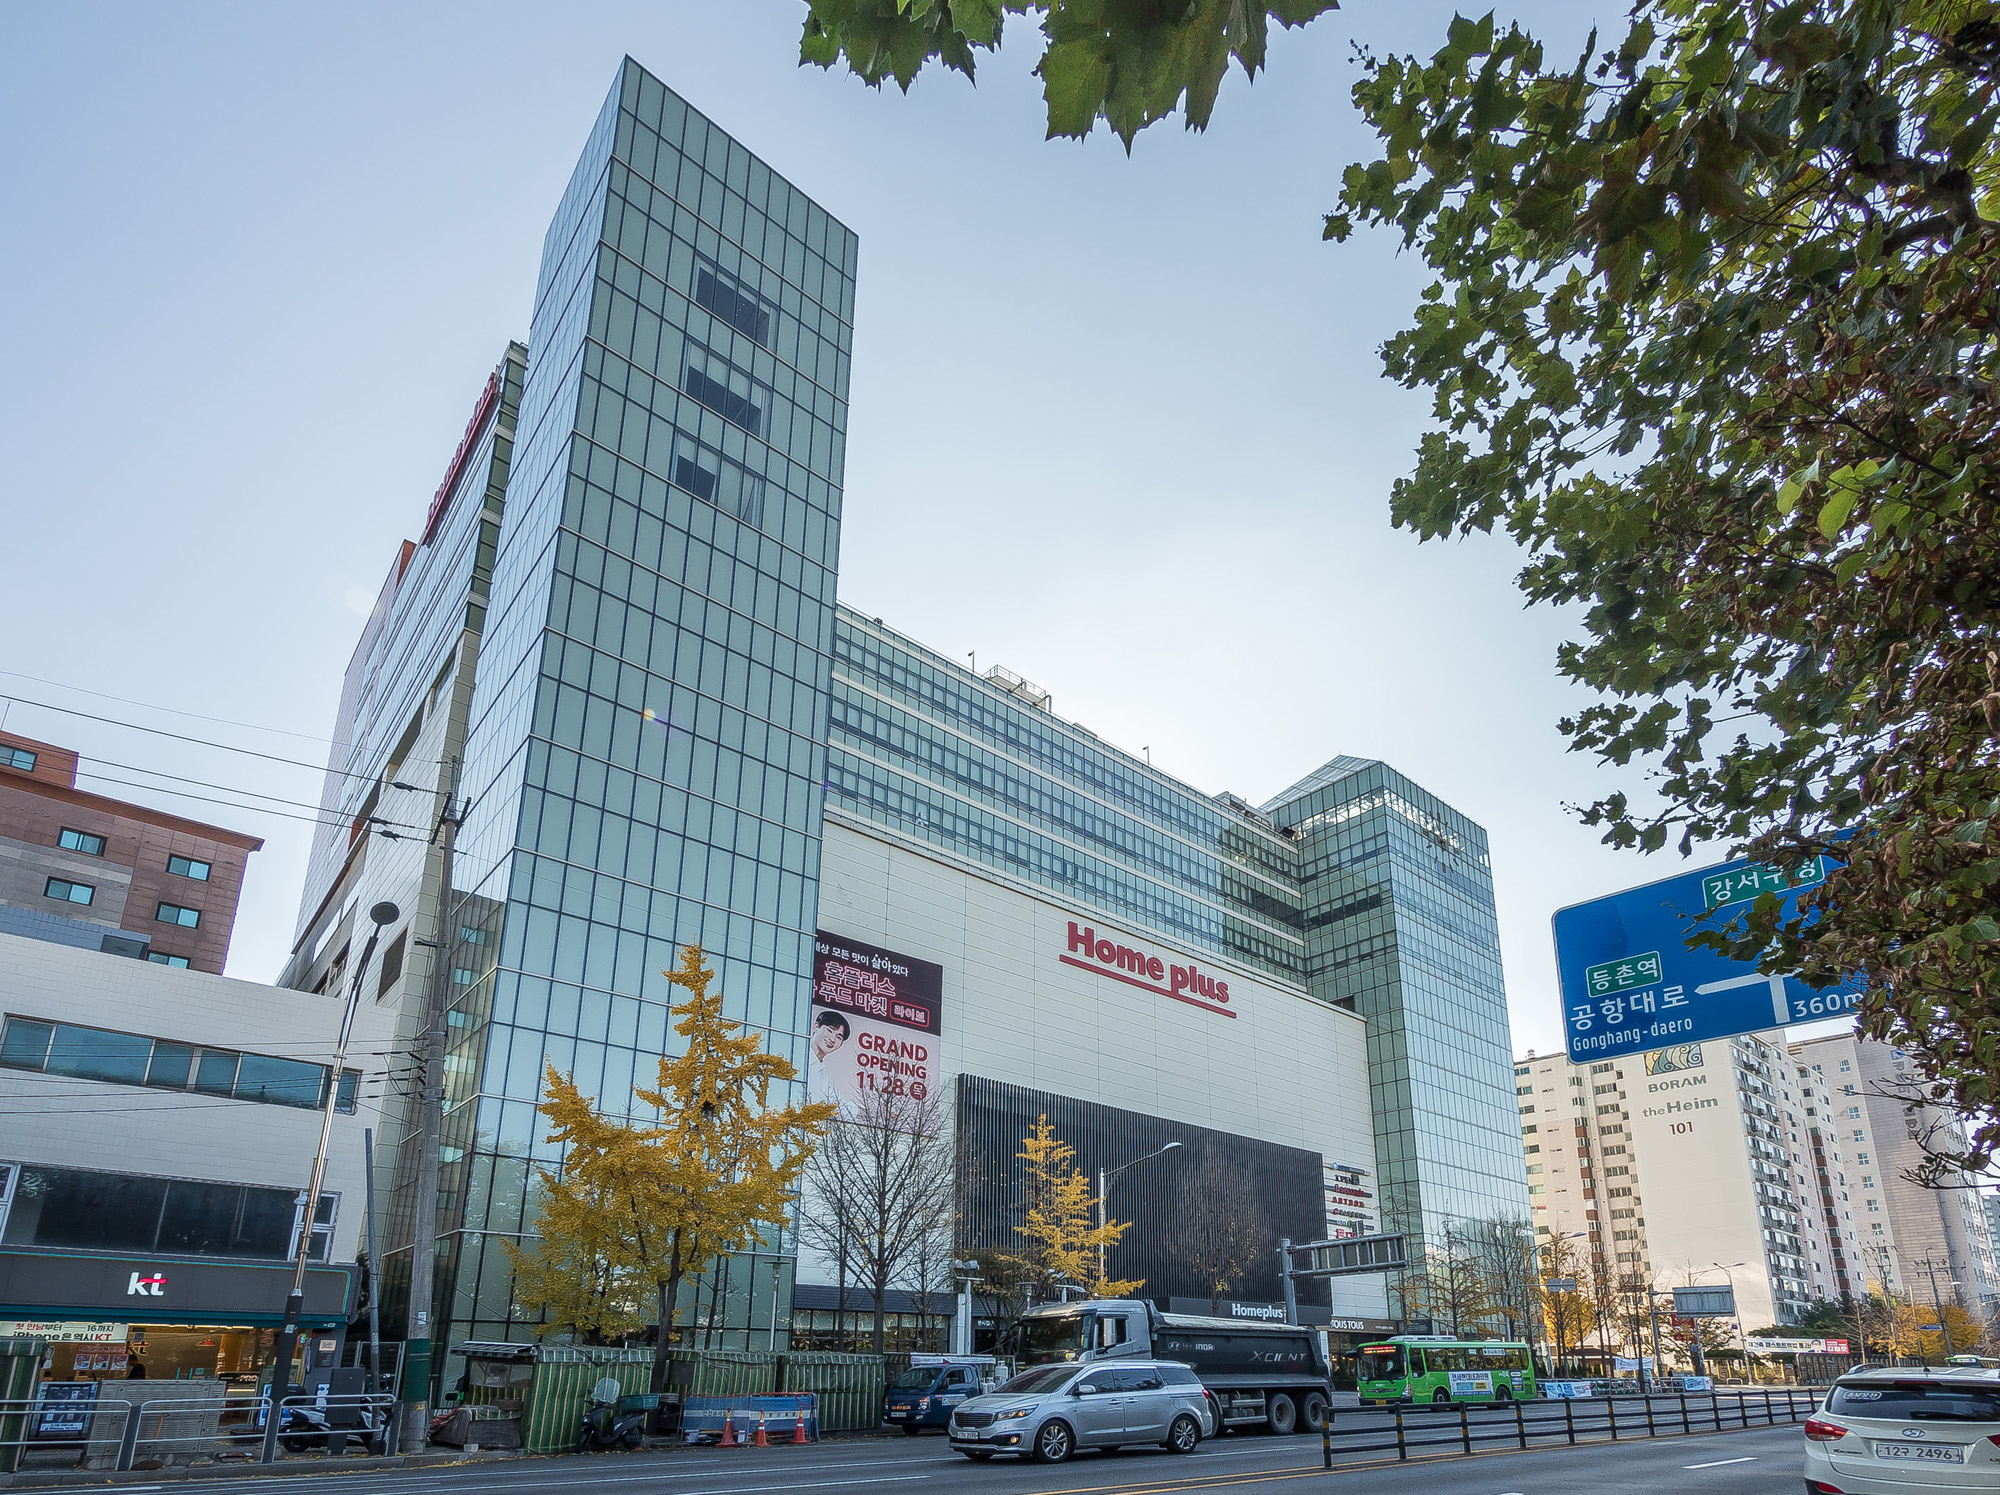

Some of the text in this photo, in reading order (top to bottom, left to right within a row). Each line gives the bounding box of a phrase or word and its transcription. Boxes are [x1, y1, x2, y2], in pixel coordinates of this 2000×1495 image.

[832, 946, 850, 960] 모든
[851, 952, 869, 966] 맛이
[1067, 920, 1230, 1003] Home plus
[824, 961, 896, 997] 홈플러스
[1591, 957, 1658, 990] 등촌역
[894, 1005, 926, 1023] 라이브
[1570, 985, 1689, 1030] 공항대로
[1793, 993, 1864, 1018] 360m
[858, 1032, 928, 1062] GRAND
[1573, 1018, 1693, 1051] Gonghang-daero
[857, 1052, 927, 1079] OPENING
[1648, 1075, 1707, 1093] BORAM
[1669, 1121, 1693, 1135] 101
[126, 1272, 168, 1296] kt
[1231, 1303, 1283, 1321] Homeplus
[1884, 1446, 1953, 1460] 12구 2496
